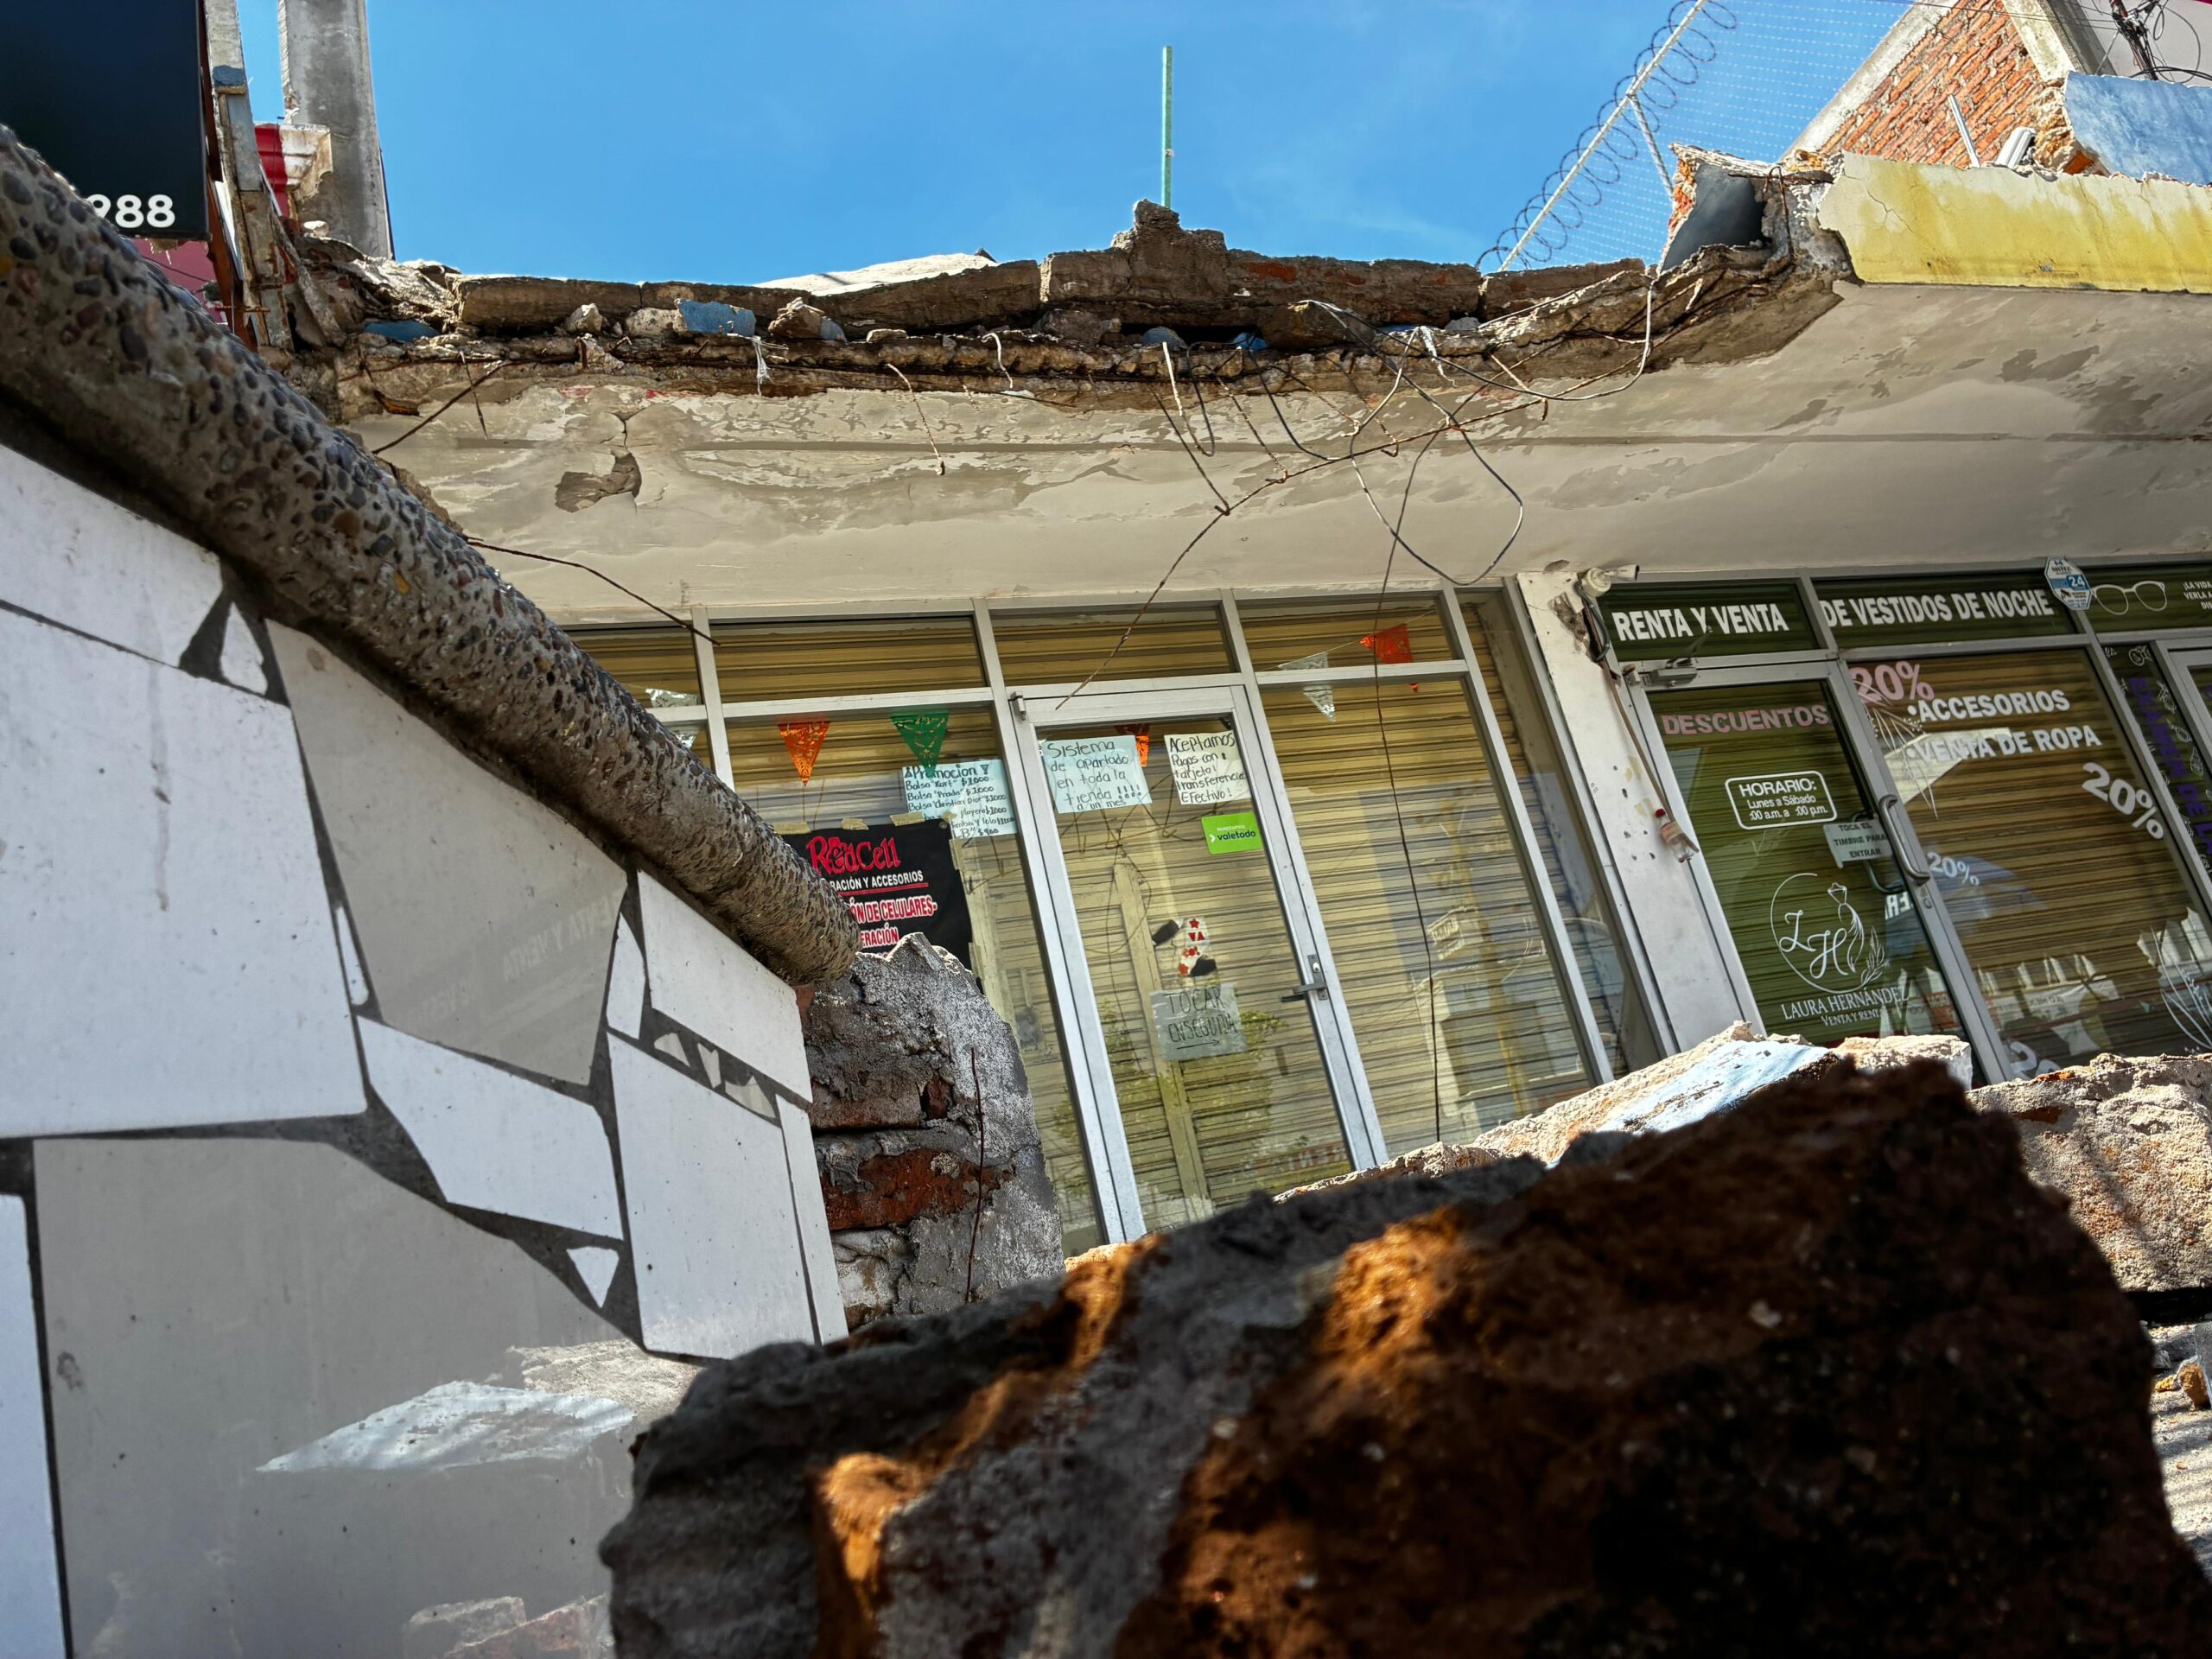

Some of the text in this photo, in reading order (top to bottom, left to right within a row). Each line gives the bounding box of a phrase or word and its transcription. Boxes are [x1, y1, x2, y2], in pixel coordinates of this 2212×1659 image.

[1820, 599, 1853, 627] DE
[1849, 594, 1953, 626] VESTIDOS
[1951, 592, 1985, 620] DE
[1982, 589, 2055, 619] NOCHE
[1612, 603, 1789, 641] RENTA Y VENTA
[1849, 660, 1936, 704] 20%
[1918, 690, 2070, 722] ACCESORIOS
[1661, 704, 1830, 734] DESCUENTOS
[1047, 740, 1116, 759] Sistema
[1913, 724, 2103, 765] VENTA DE ROPA
[1051, 753, 1128, 772] de apartado
[906, 779, 931, 791] Bolsa
[1057, 769, 1126, 789] en toda la
[1738, 778, 1817, 798] HORARIO:
[907, 791, 932, 801] Bolsa
[1106, 798, 1127, 809] mes
[1746, 793, 1816, 810] Lunes a Sábado
[2081, 761, 2164, 840] 20%
[908, 802, 932, 812] Bolsa
[1217, 829, 1256, 841] valetodo
[1838, 823, 1860, 831] TOCA
[1832, 833, 1888, 848] TIMBRE PARA
[1848, 848, 1883, 859] ENTRAR
[862, 876, 869, 888] Y
[871, 869, 924, 888] ACCESORIOS
[1926, 850, 1980, 887] 20%
[865, 900, 881, 922] DE
[1162, 986, 1225, 1014] TOCAR
[1781, 997, 1828, 1020] LAURA
[1827, 987, 1910, 1013] HERNÁNDEZ
